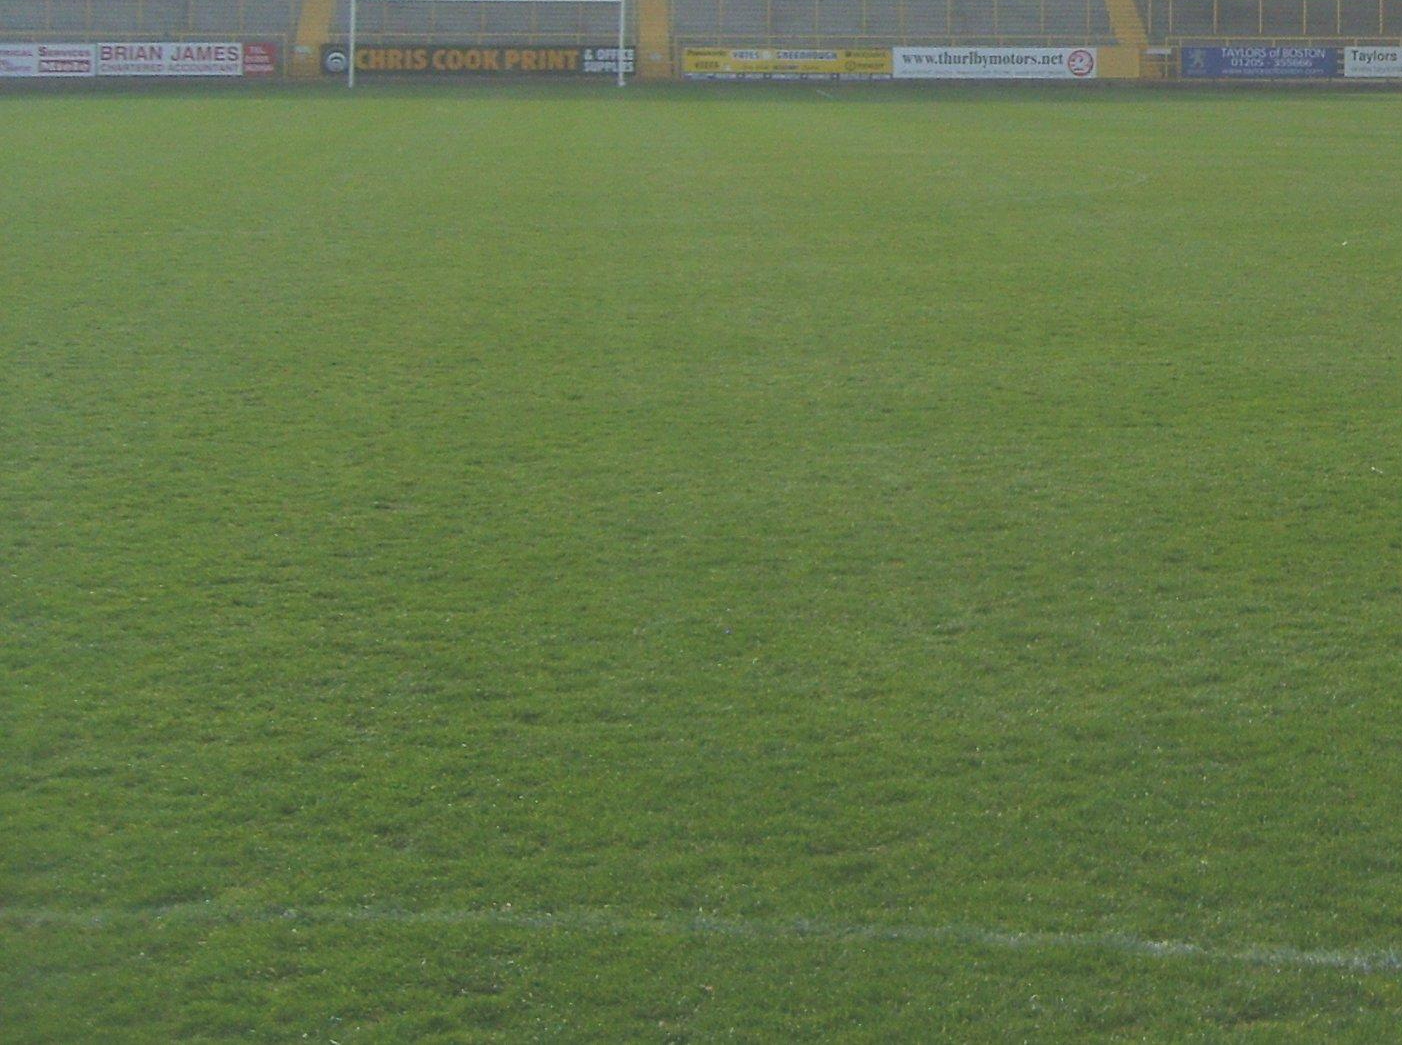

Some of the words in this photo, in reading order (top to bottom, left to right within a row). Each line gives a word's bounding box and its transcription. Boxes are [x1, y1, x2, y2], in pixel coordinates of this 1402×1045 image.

[100, 45, 164, 62] BRIAN
[171, 45, 240, 62] JAMES
[356, 48, 429, 71] CHRIS
[433, 49, 499, 71] COOK
[505, 49, 578, 71] PRINT
[902, 51, 1063, 68] www.thurlbymotors.net
[1221, 47, 1266, 58] TAYLORS
[1269, 47, 1279, 58] of
[1282, 48, 1325, 58] BOSTON
[1351, 50, 1398, 64] Taylors
[1231, 58, 1264, 67] 01205
